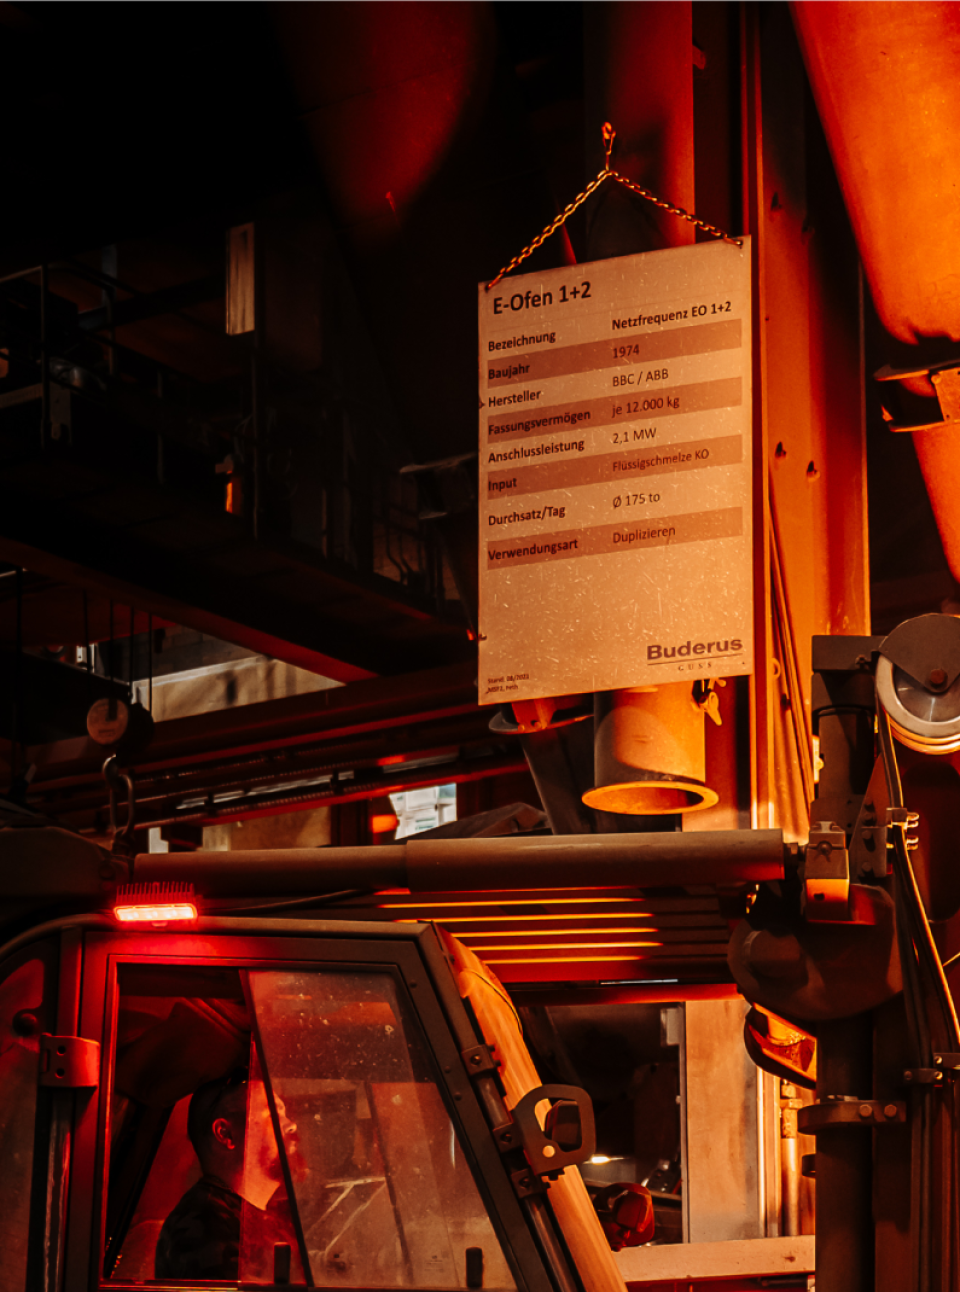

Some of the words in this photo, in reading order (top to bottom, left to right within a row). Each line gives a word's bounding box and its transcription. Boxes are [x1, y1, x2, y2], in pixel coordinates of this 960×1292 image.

[493, 290, 553, 315] E-Ofen
[559, 281, 591, 302] 1+2
[612, 310, 688, 330] Netzfrequenz
[691, 304, 707, 317] EO
[711, 301, 732, 315] 1+2
[488, 331, 556, 351] Bezeichnung
[613, 344, 640, 358] 1974
[488, 363, 530, 380] Baujahr
[612, 373, 635, 387] BBC
[645, 368, 669, 382] ABB
[488, 390, 541, 407] Hersteller
[611, 404, 623, 418] je
[626, 398, 664, 414] 12.000
[667, 395, 680, 409] kg
[488, 409, 591, 435] Fassungsvermögen
[613, 431, 630, 445] 2,1
[633, 428, 657, 441] MW
[488, 438, 585, 463] Anschlussleistung
[613, 451, 692, 473] Flüssigschmelze
[695, 449, 710, 460] KO
[488, 477, 518, 492] Input
[625, 493, 646, 506] 175
[649, 492, 661, 503] to
[488, 504, 566, 526] Durchsatz/Tag
[613, 526, 676, 544] Duplizieren
[488, 538, 578, 561] Verwendungsart
[646, 638, 743, 661] Buderus
[678, 662, 712, 671] GUSS
